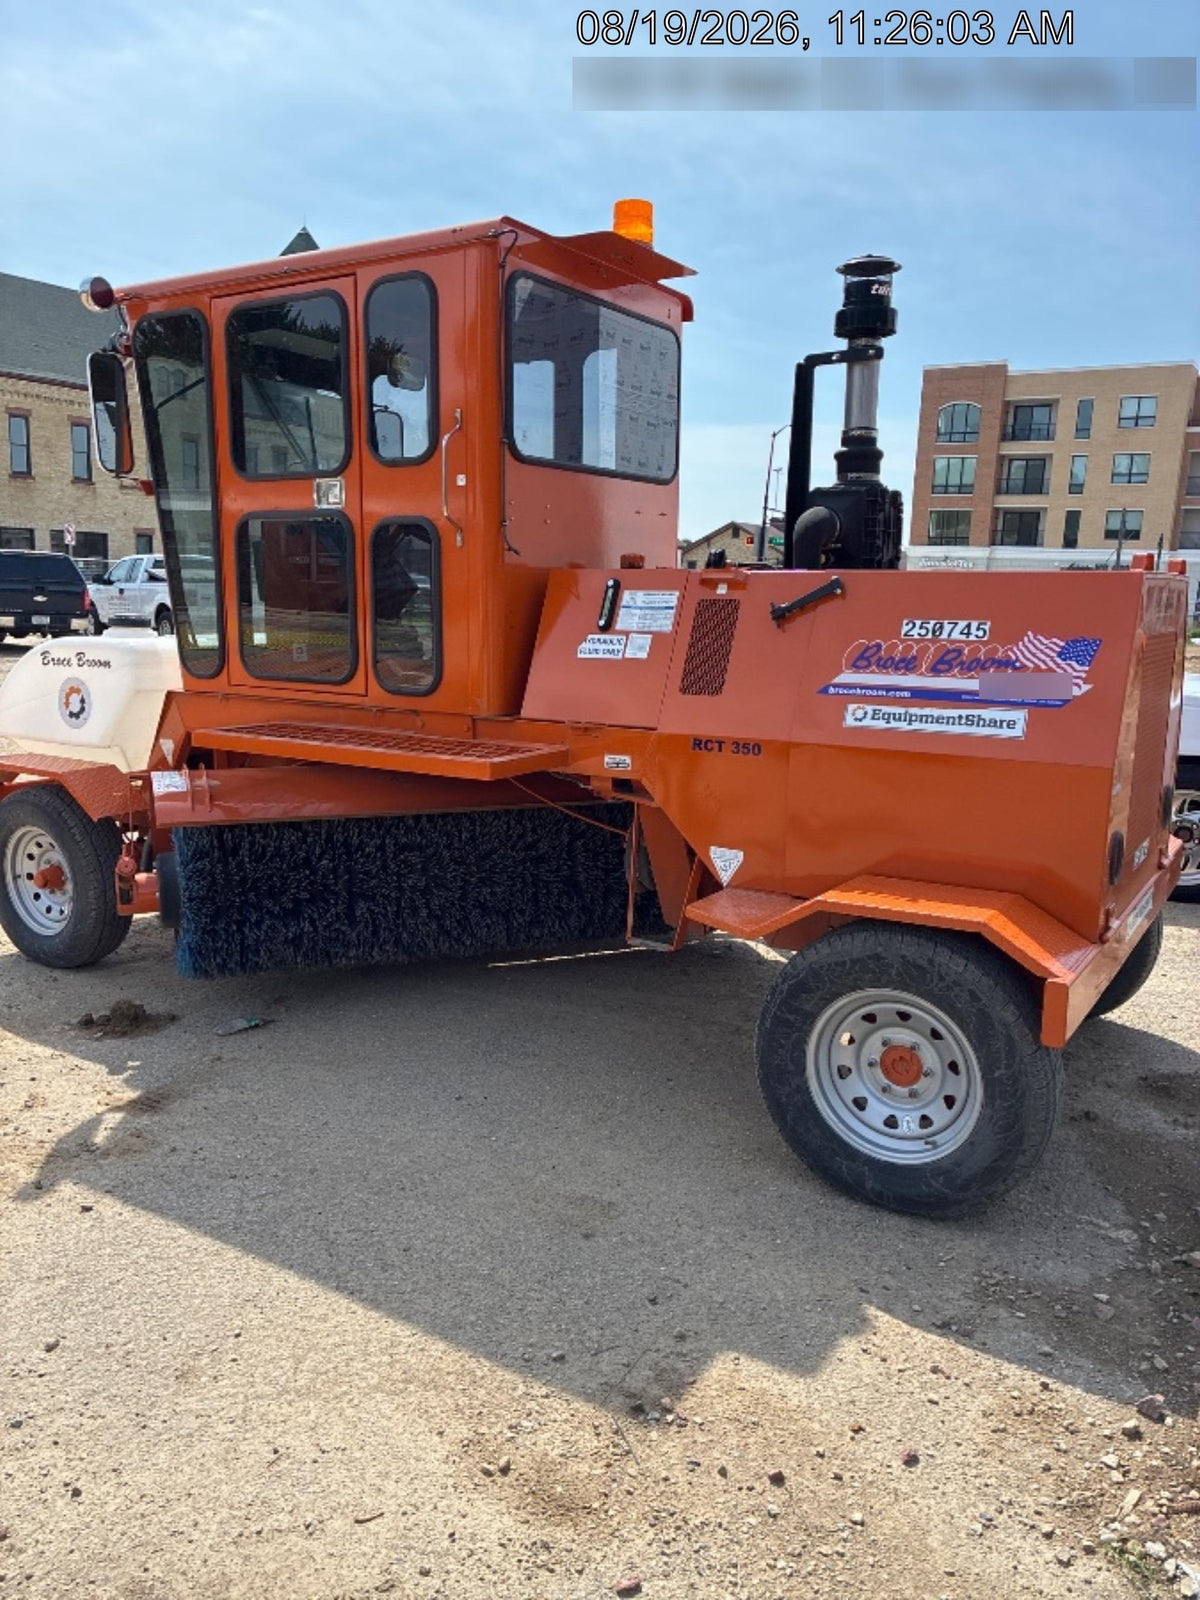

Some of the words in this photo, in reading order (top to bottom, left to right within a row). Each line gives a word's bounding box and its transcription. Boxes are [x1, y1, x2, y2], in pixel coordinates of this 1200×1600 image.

[903, 620, 988, 640] 250745
[40, 650, 72, 668] Broce
[75, 652, 112, 669] Broom
[852, 641, 917, 672] Broce
[930, 648, 1026, 674] Broom
[828, 686, 912, 698] brocebroom.com
[870, 708, 1018, 730] EquipmentShare
[692, 738, 726, 752] RCT
[731, 740, 763, 757] 350
